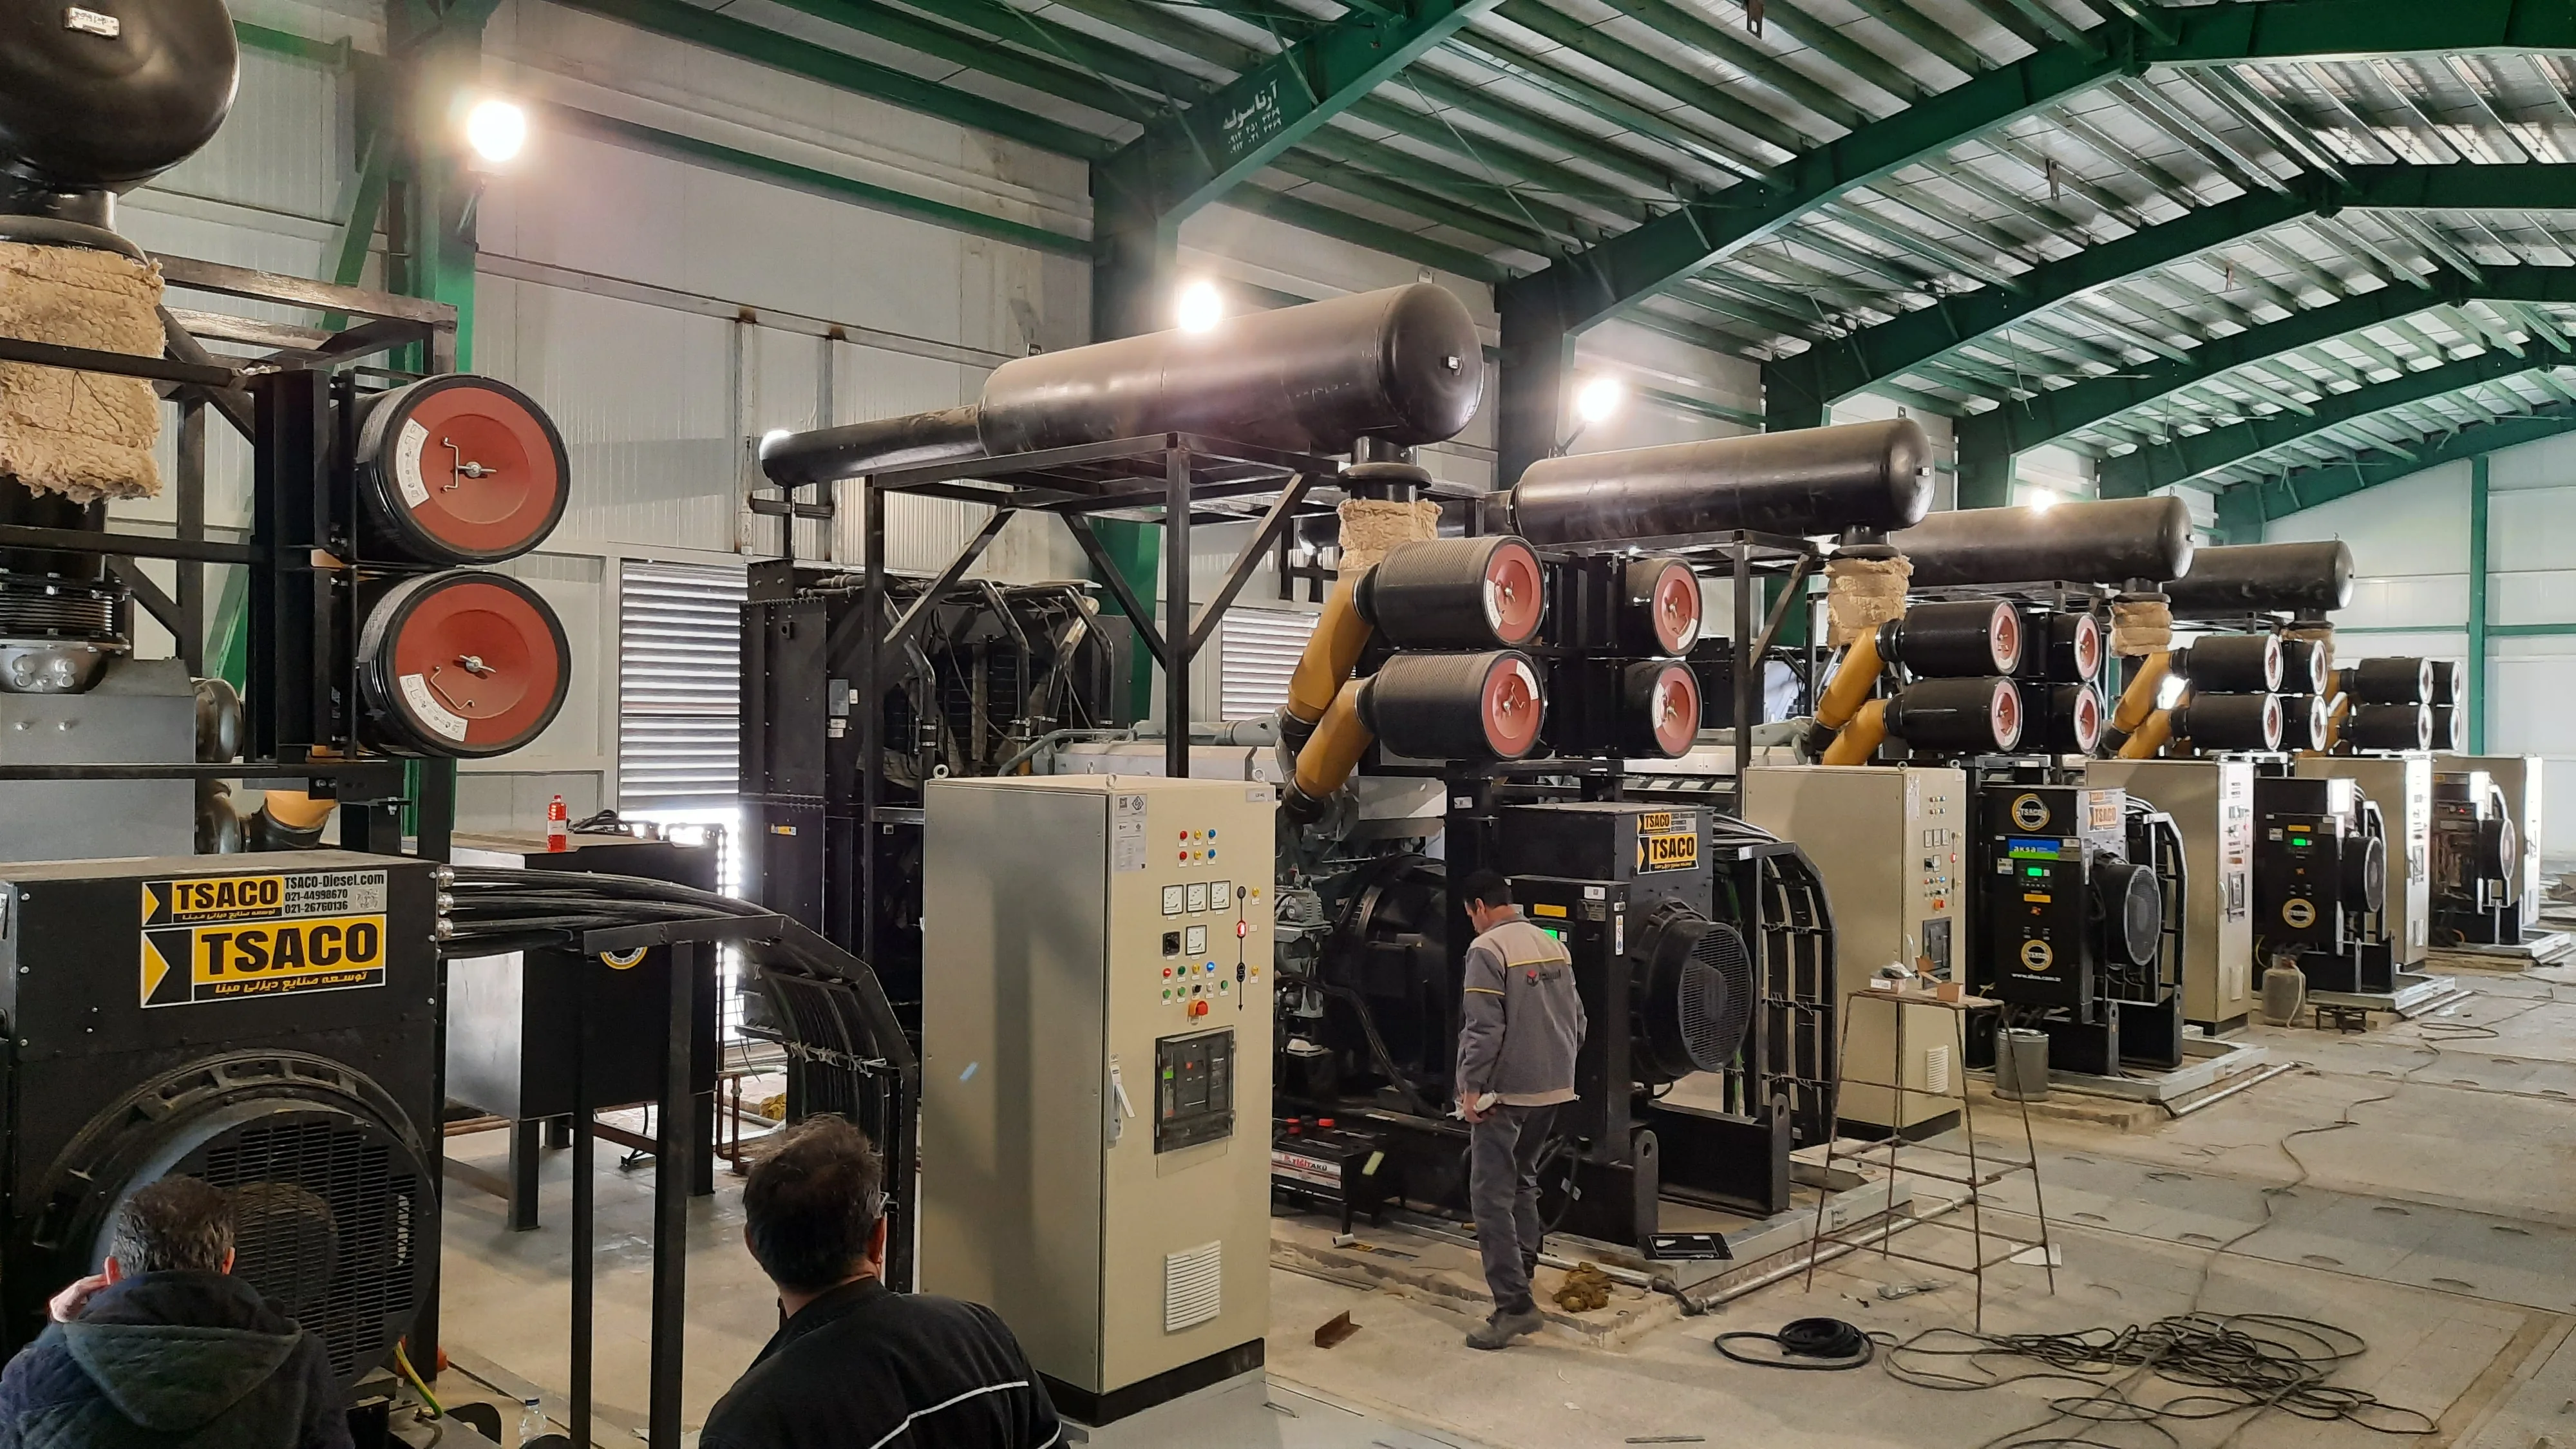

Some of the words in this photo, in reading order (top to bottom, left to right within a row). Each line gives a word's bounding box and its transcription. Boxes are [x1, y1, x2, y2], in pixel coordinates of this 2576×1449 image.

[1645, 814, 1670, 828] TSACO
[1651, 837, 1694, 859] TSACO
[285, 874, 384, 889] TSACO-Diesel.com
[176, 880, 278, 910] TSACO
[201, 923, 378, 975] TSACO
[281, 977, 318, 992] صنایع
[322, 971, 368, 984] توسعه
[215, 983, 240, 994] مبنا
[243, 981, 278, 994] دیزلی
